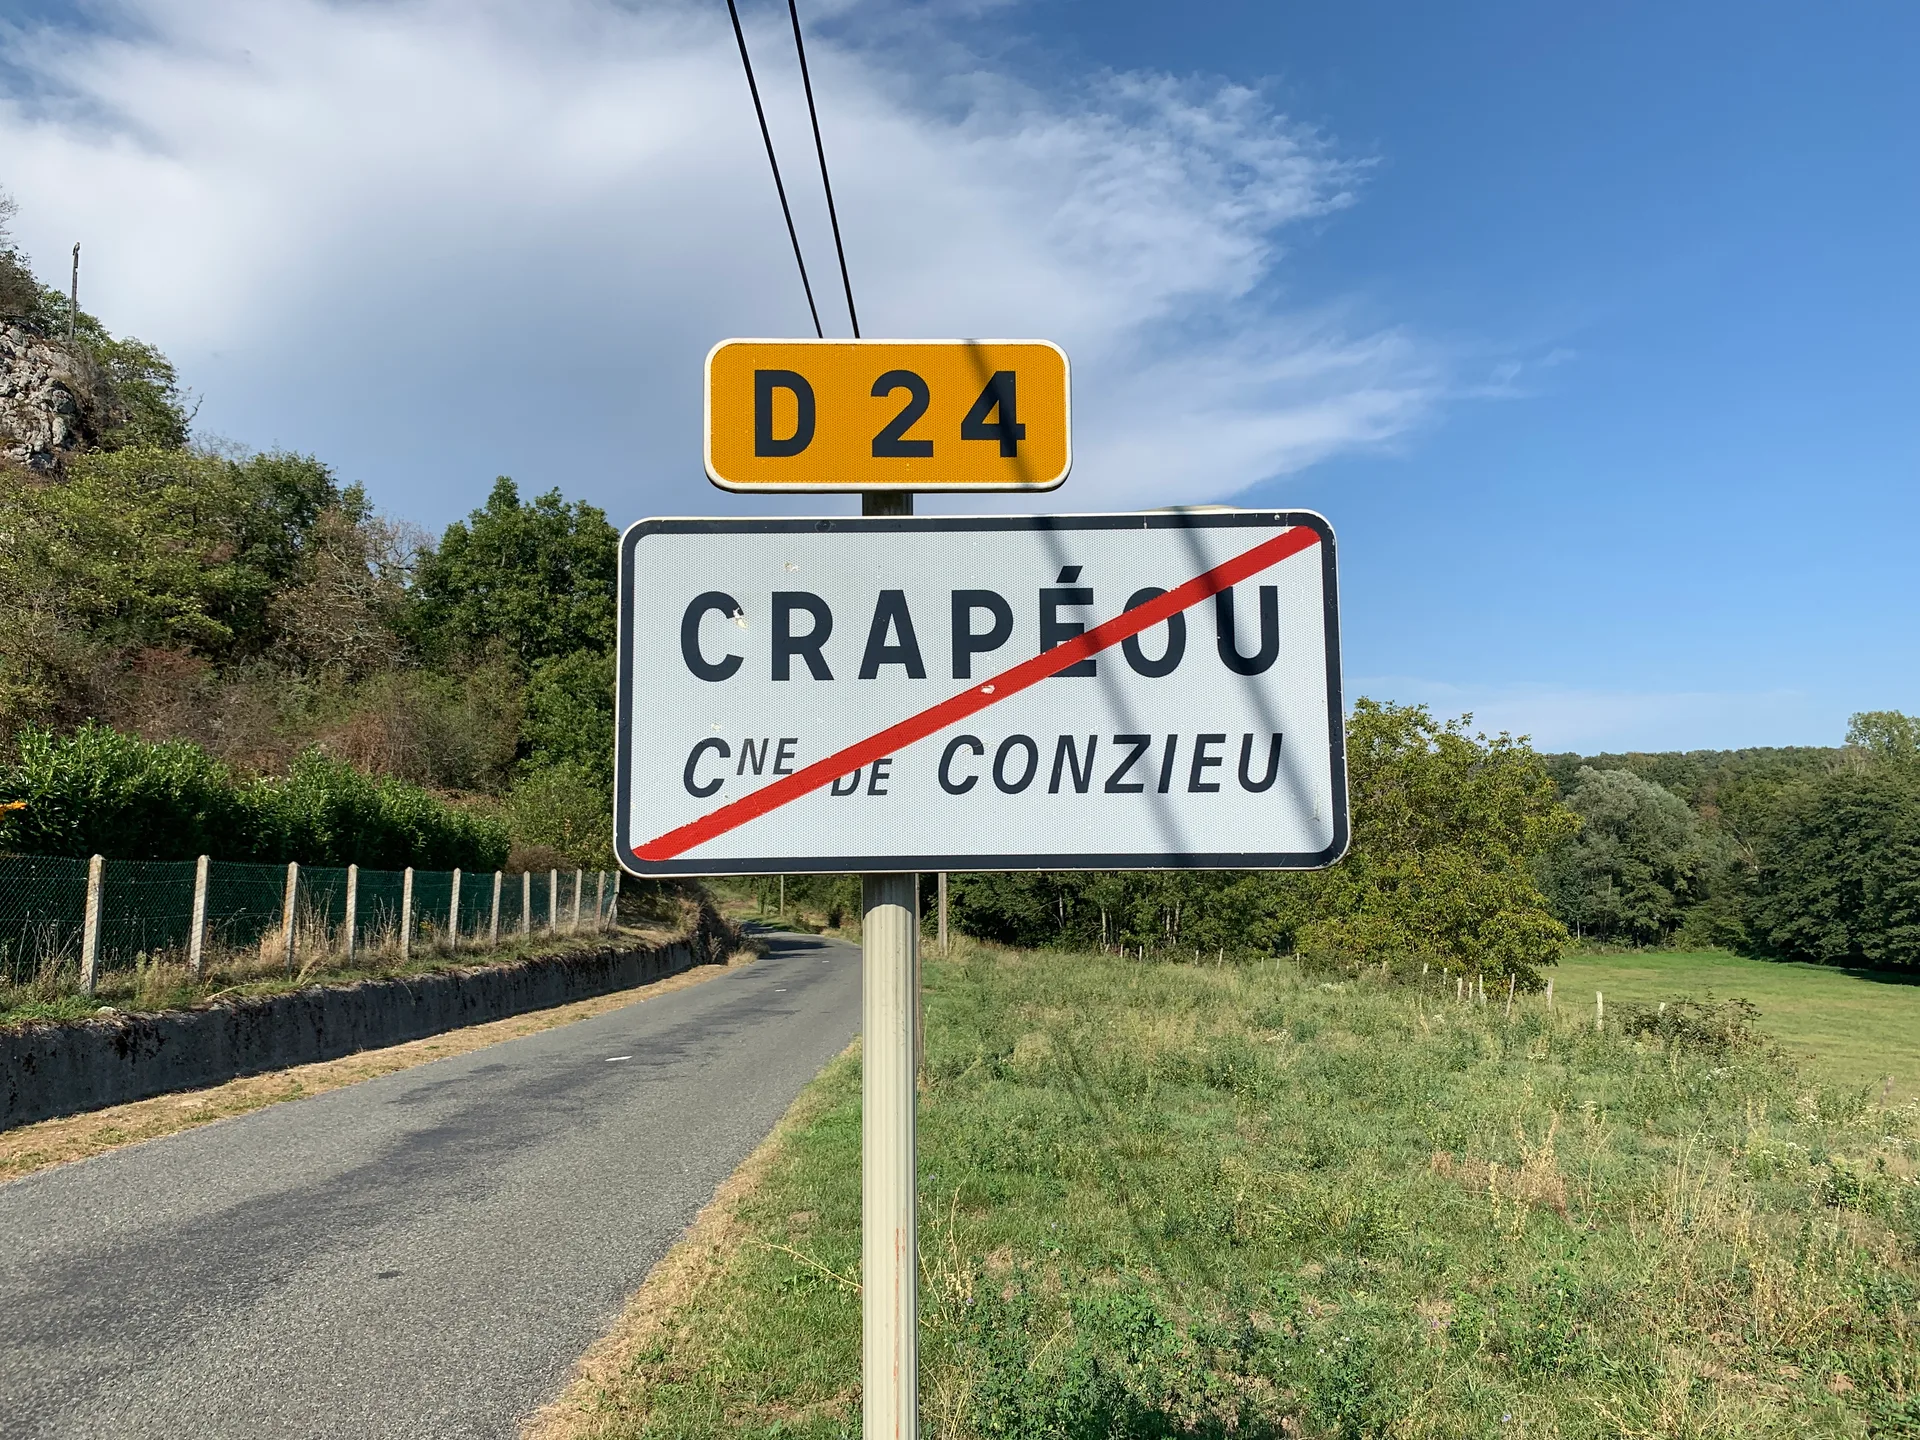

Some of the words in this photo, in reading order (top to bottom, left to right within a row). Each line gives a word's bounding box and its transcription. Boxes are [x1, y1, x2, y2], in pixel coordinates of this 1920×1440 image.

[754, 369, 816, 458] D
[870, 369, 1026, 458] 24
[680, 565, 1281, 683] CRAPÉOU
[683, 737, 798, 798] CNE
[830, 758, 893, 797] DE
[938, 732, 1283, 796] CONZIEU
